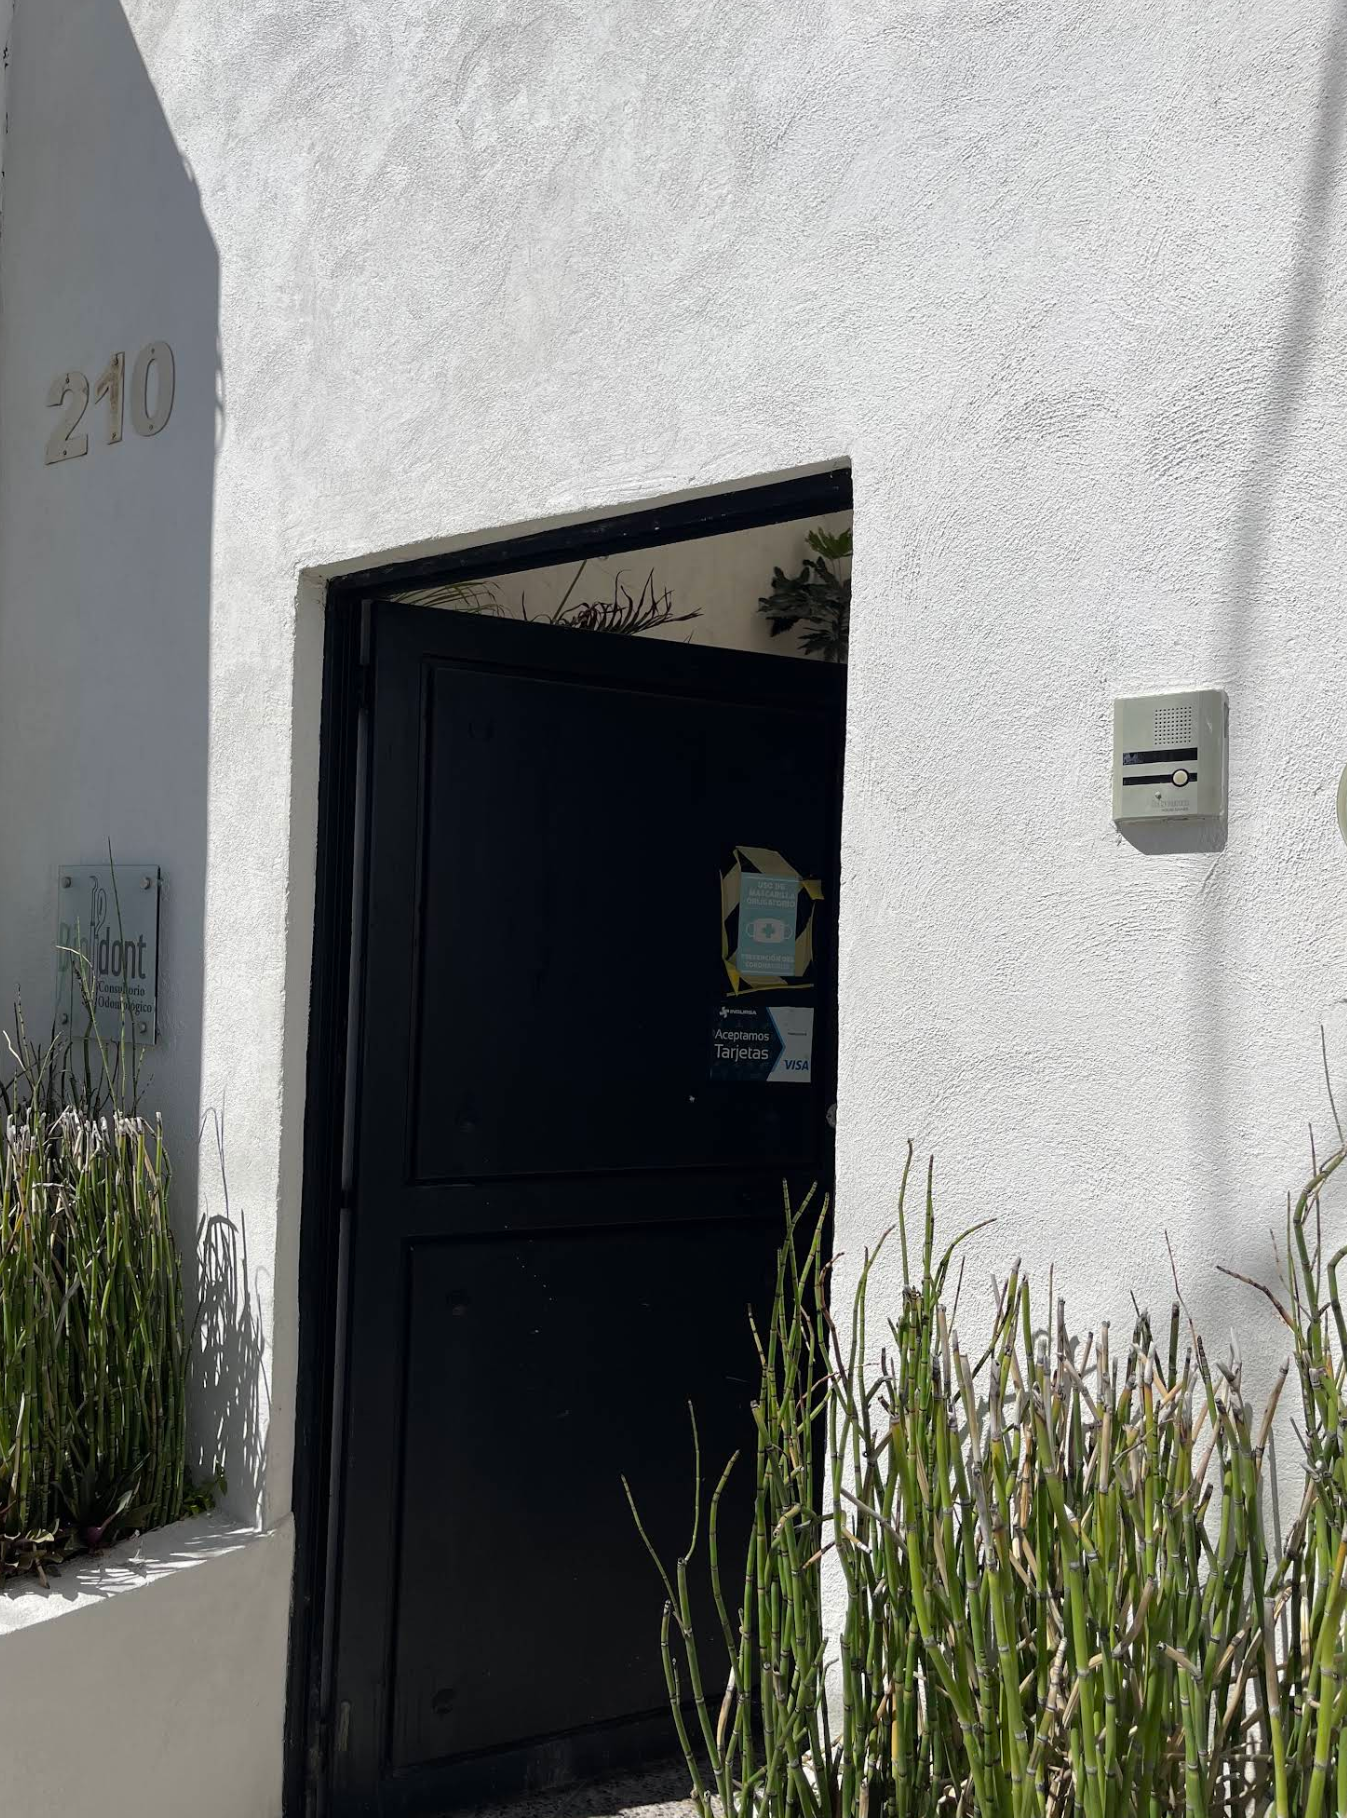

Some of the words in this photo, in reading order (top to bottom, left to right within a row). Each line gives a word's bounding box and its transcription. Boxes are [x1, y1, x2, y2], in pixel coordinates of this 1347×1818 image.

[45, 341, 175, 465] 210
[757, 881, 773, 889] USO
[774, 882, 786, 890] DE
[749, 888, 796, 900] MASCARILLA
[746, 897, 796, 908] OBLIGATORIO
[714, 1028, 770, 1042] Aceptamos
[713, 1043, 769, 1062] Tarjetas
[784, 1059, 810, 1071] VISA
